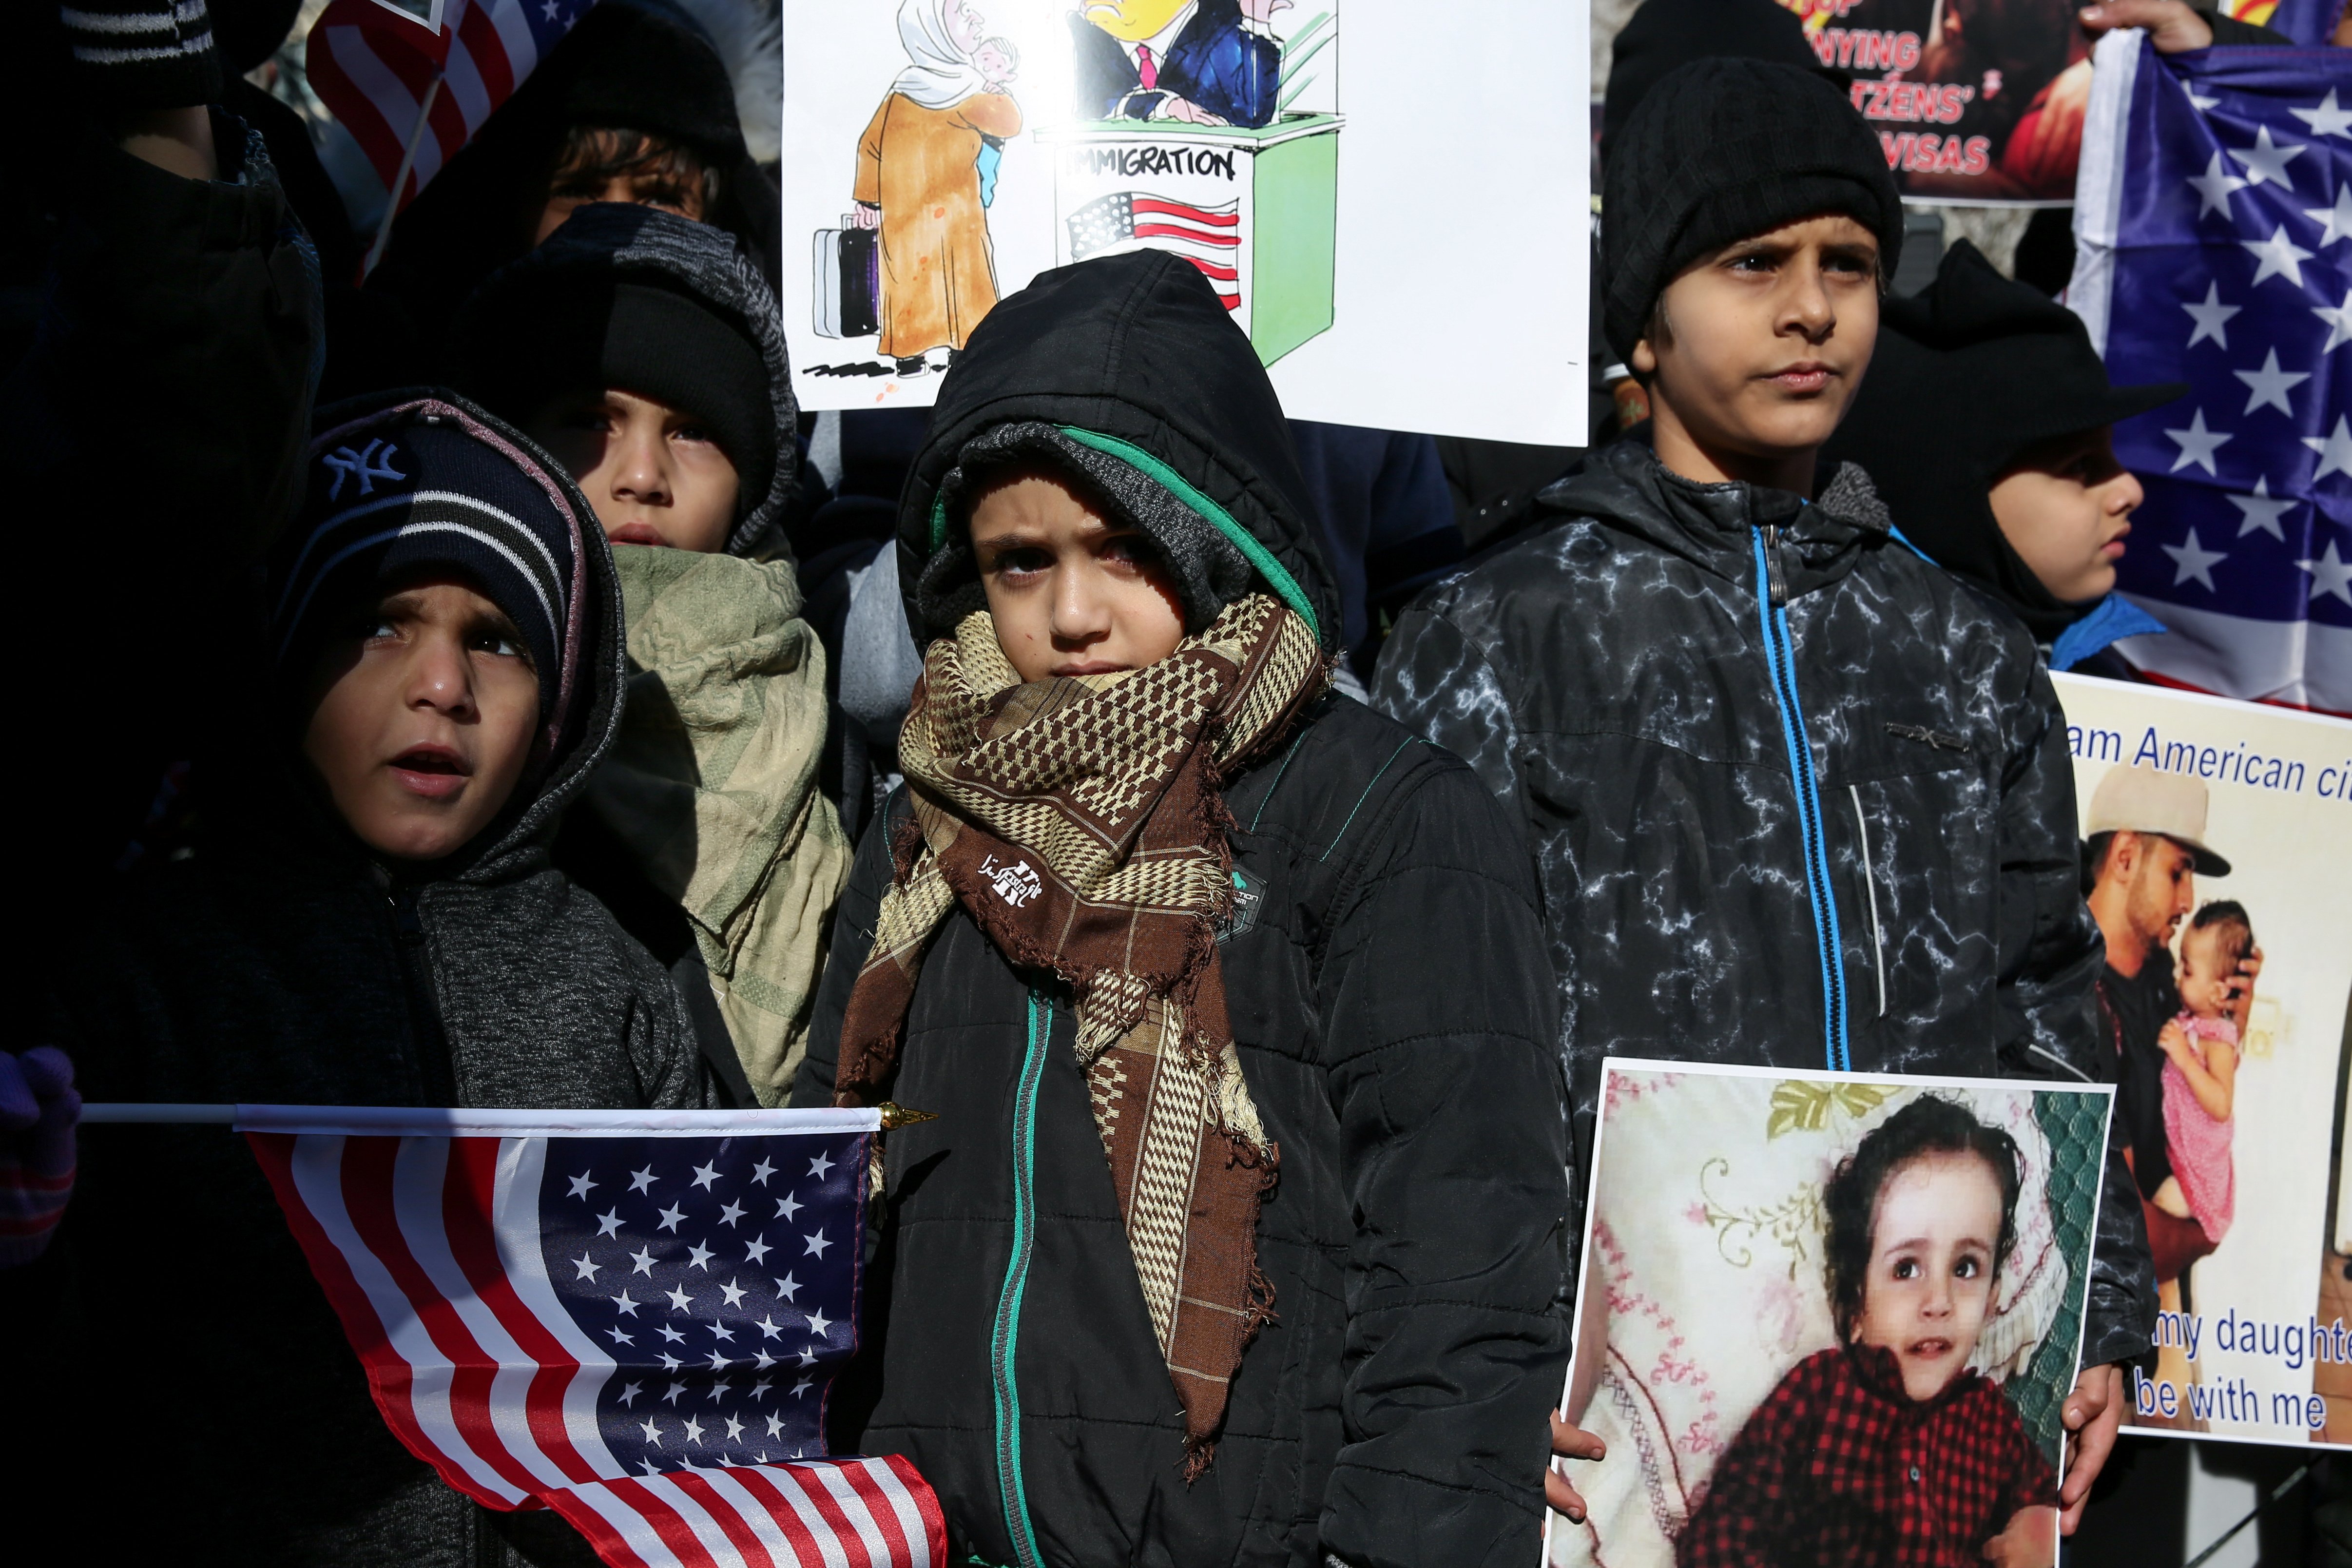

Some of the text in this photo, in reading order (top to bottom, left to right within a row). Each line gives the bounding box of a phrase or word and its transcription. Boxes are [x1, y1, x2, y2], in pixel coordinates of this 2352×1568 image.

[1066, 147, 1235, 181] IMMIGRATION
[1880, 131, 1991, 175] VISAS
[322, 438, 406, 503] NY
[2066, 725, 2122, 763] am
[2133, 726, 2305, 793] American
[2153, 1311, 2203, 1360] my
[2135, 1367, 2325, 1428] be with me
